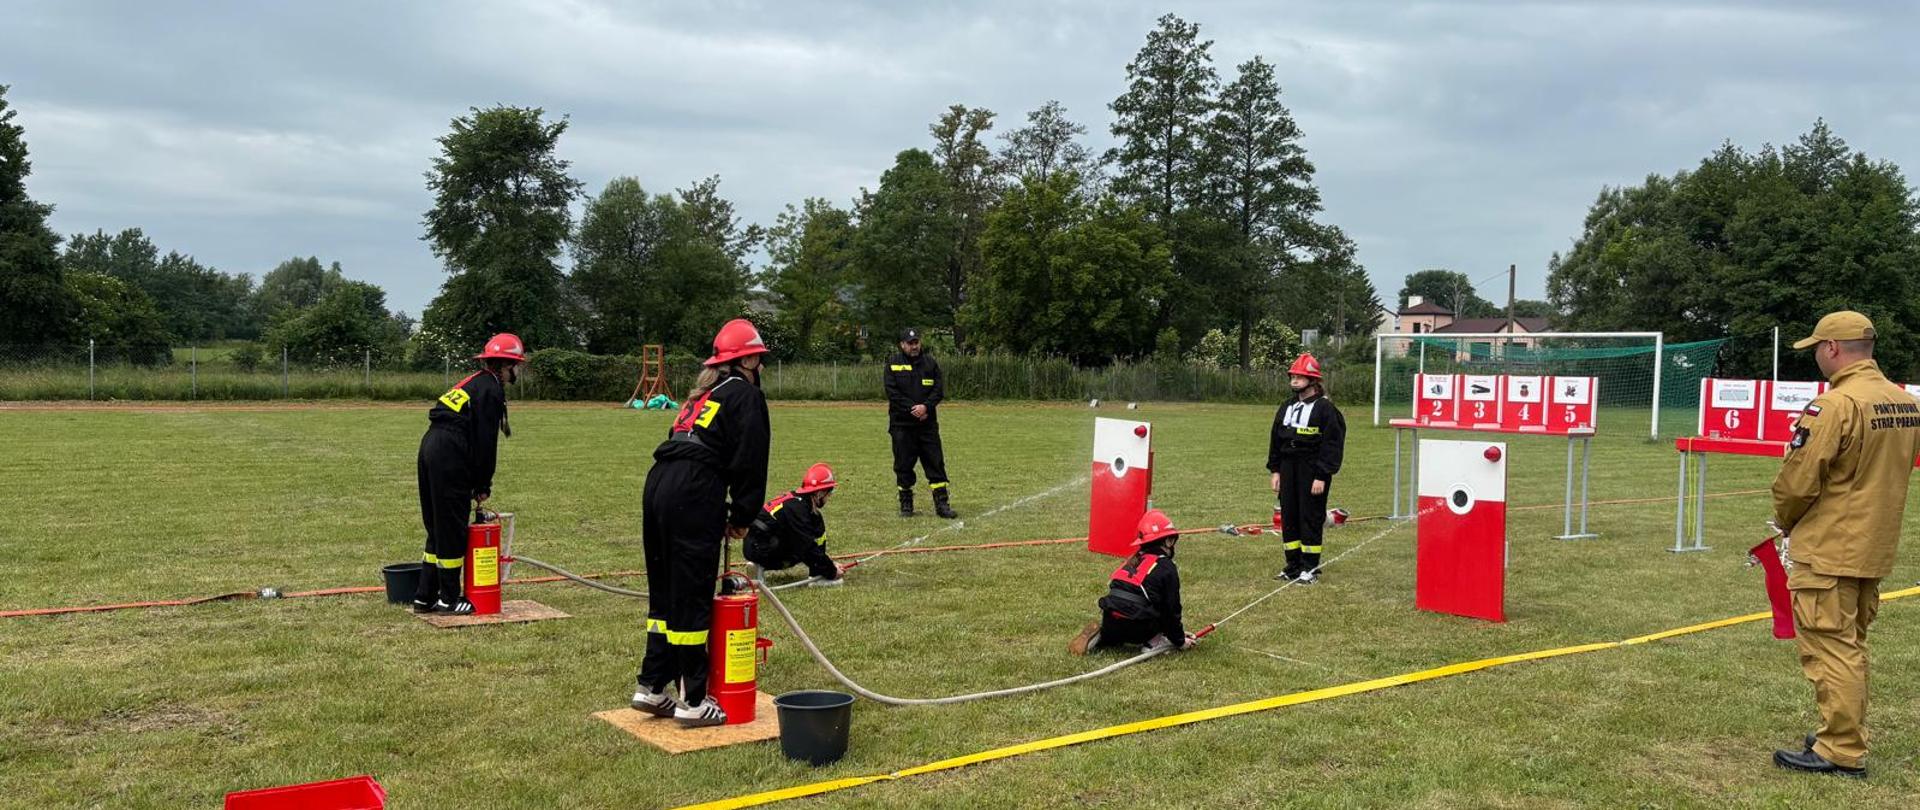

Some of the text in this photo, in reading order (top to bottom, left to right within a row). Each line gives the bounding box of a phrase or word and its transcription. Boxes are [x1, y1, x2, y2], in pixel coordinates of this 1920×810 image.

[1432, 400, 1443, 417] 2
[1474, 401, 1485, 418] 3
[1518, 403, 1530, 420] 4
[1564, 405, 1577, 423] 5
[1724, 409, 1740, 429] 6
